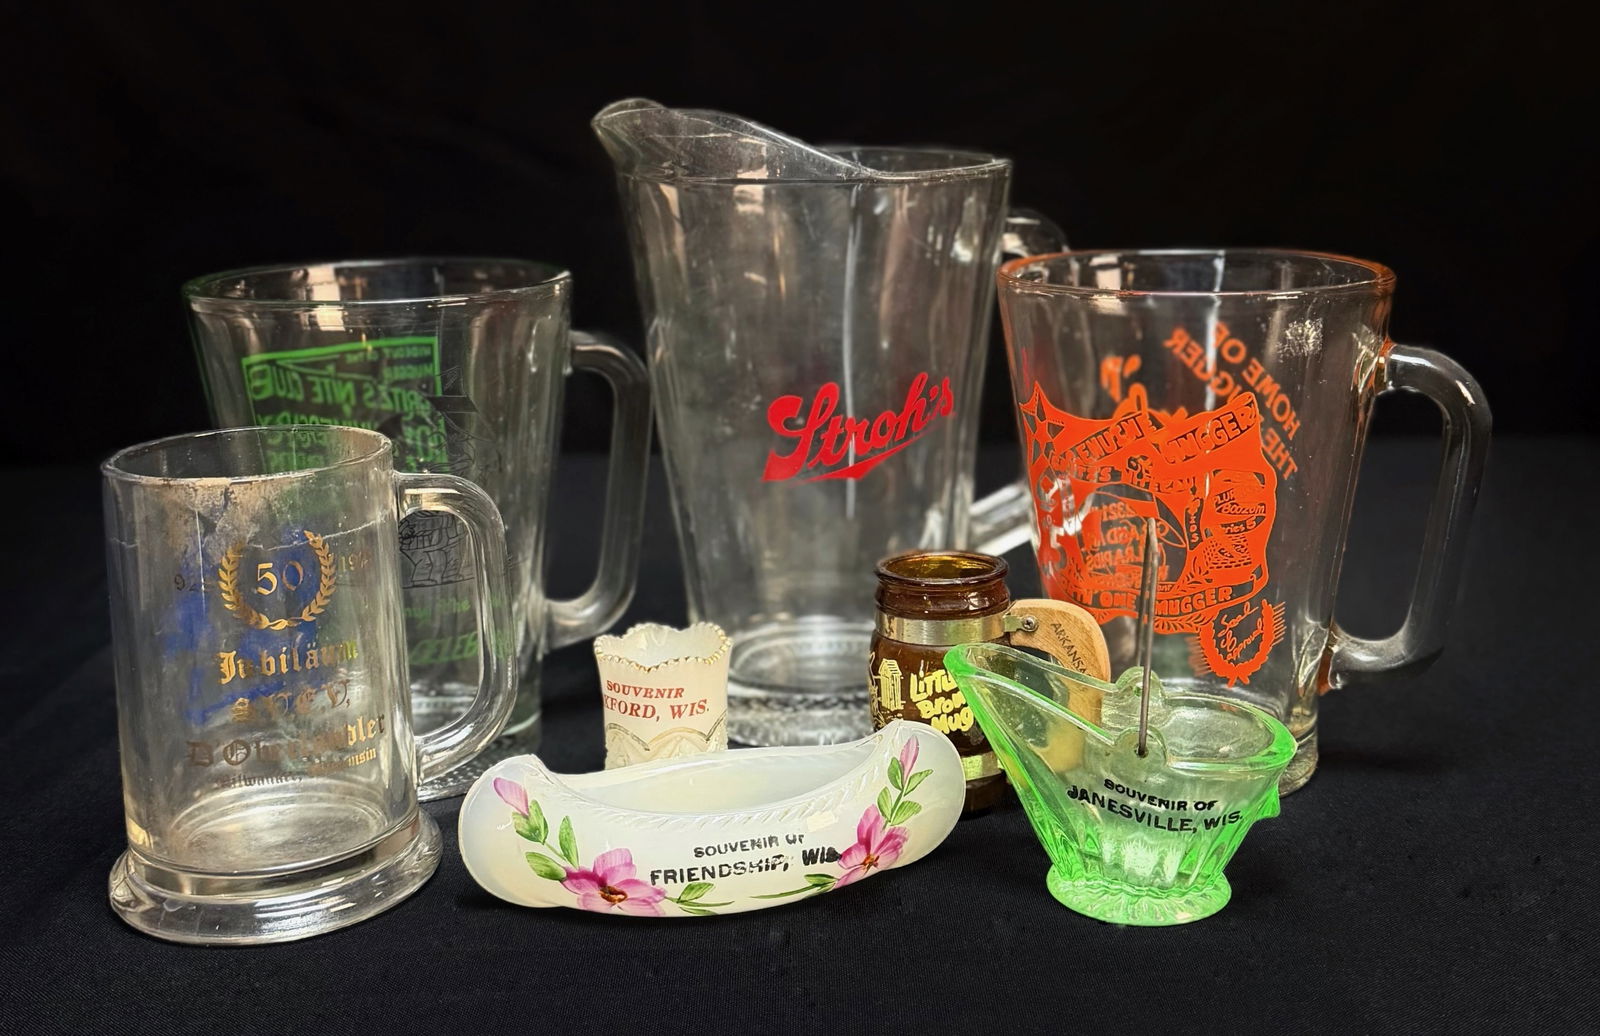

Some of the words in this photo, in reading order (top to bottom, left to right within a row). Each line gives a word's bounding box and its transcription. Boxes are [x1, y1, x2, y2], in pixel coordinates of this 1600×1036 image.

[760, 371, 957, 484] Stroh's
[256, 560, 305, 596] 50
[1154, 586, 1233, 615] MUGGER
[1051, 621, 1096, 678] ARKANSA
[606, 679, 685, 699] SOUVENIR
[916, 690, 966, 719] Brow
[669, 698, 710, 720] WIS.
[1067, 785, 1198, 833] JANESVILLE,
[1204, 810, 1243, 831] WIS.
[1103, 778, 1188, 811] SOUVENIR
[1193, 800, 1219, 811] OF
[693, 834, 779, 858] SOUVENIR
[650, 854, 791, 886] FRIENDSHIP,
